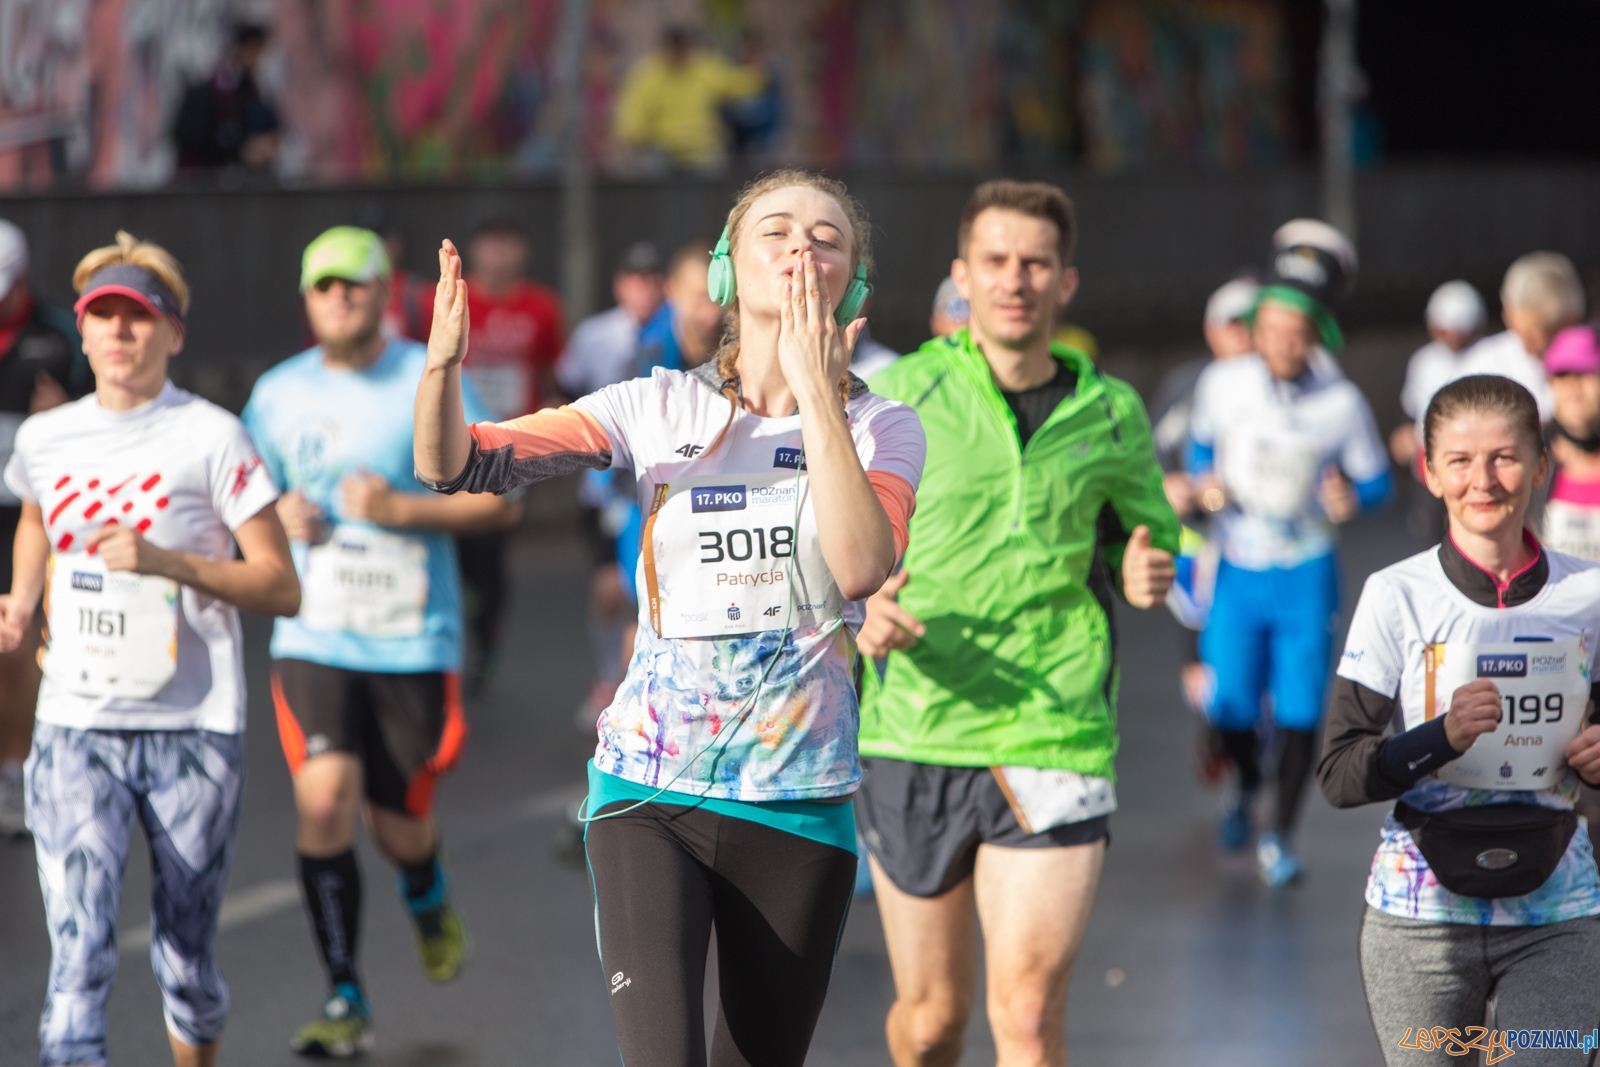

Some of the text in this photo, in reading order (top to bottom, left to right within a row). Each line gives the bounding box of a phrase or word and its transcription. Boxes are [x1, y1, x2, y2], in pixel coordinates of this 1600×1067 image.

[675, 443, 705, 458] 4F
[752, 495, 796, 504] maraton
[698, 525, 796, 564] 3018
[717, 569, 784, 587] Patrycja
[763, 605, 782, 617] 4F
[78, 607, 126, 637] 1161
[1532, 664, 1566, 672] maraton
[1498, 693, 1565, 725] 199
[1504, 734, 1543, 747] Anna
[1532, 766, 1549, 777] 4F
